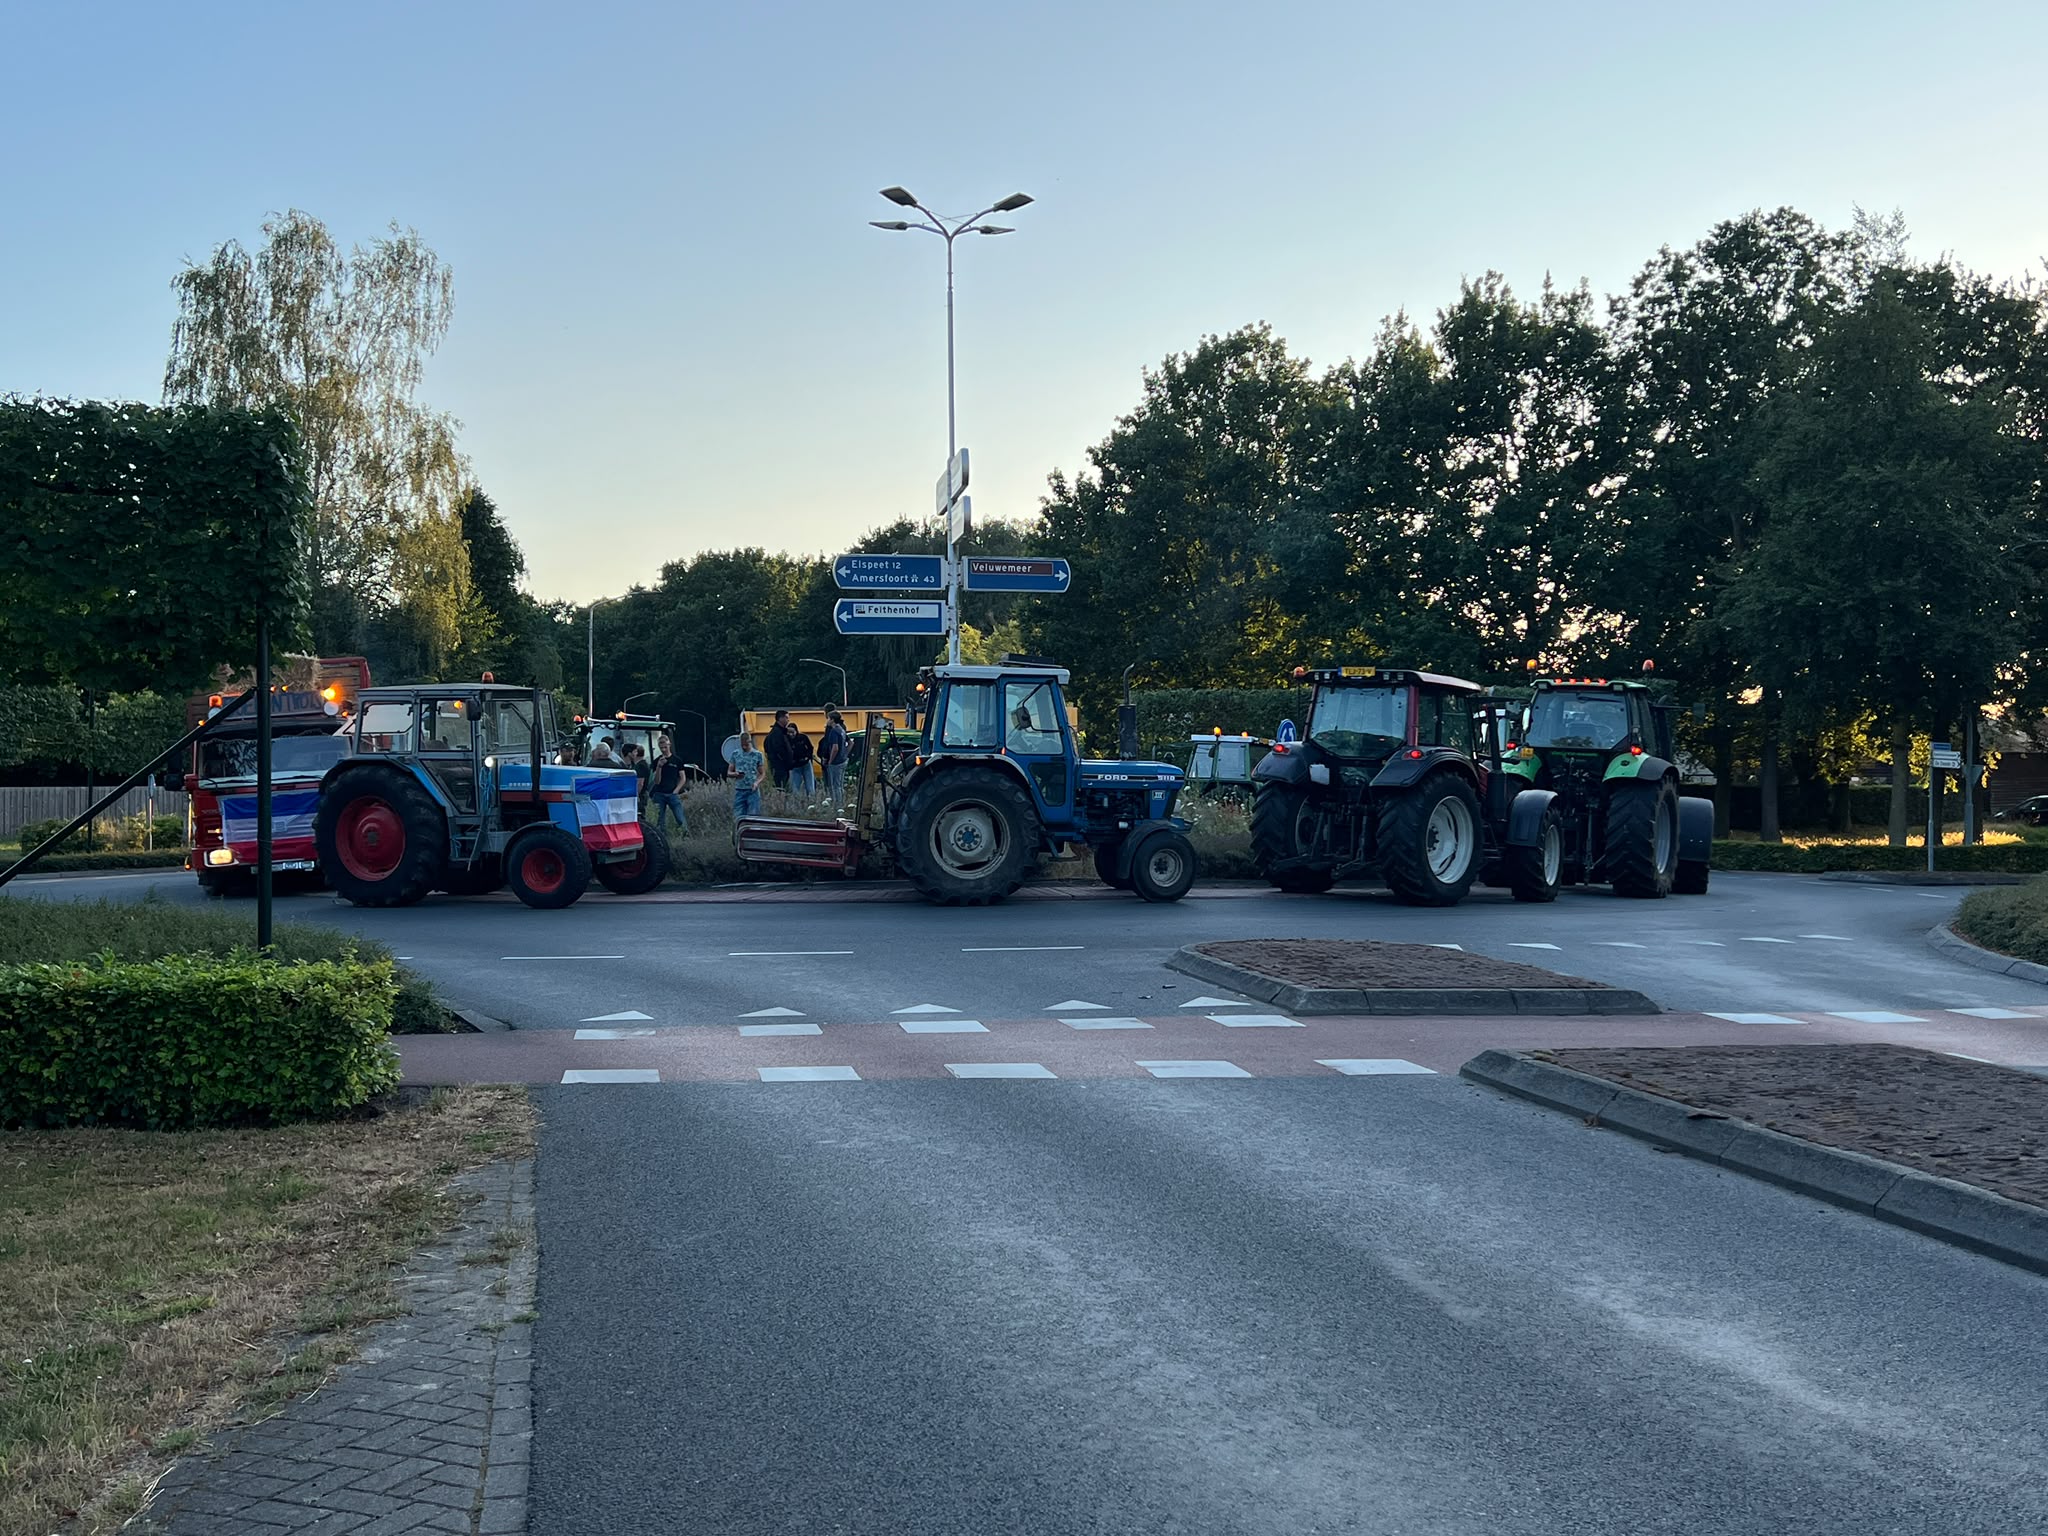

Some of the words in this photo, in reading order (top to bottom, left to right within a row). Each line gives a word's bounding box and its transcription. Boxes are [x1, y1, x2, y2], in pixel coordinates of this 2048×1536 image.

[851, 559, 889, 570] Elspeet
[972, 562, 1032, 573] Veluwemeer
[851, 573, 909, 583] Amersfoort
[923, 575, 935, 583] 43
[868, 605, 920, 614] Feithenhof
